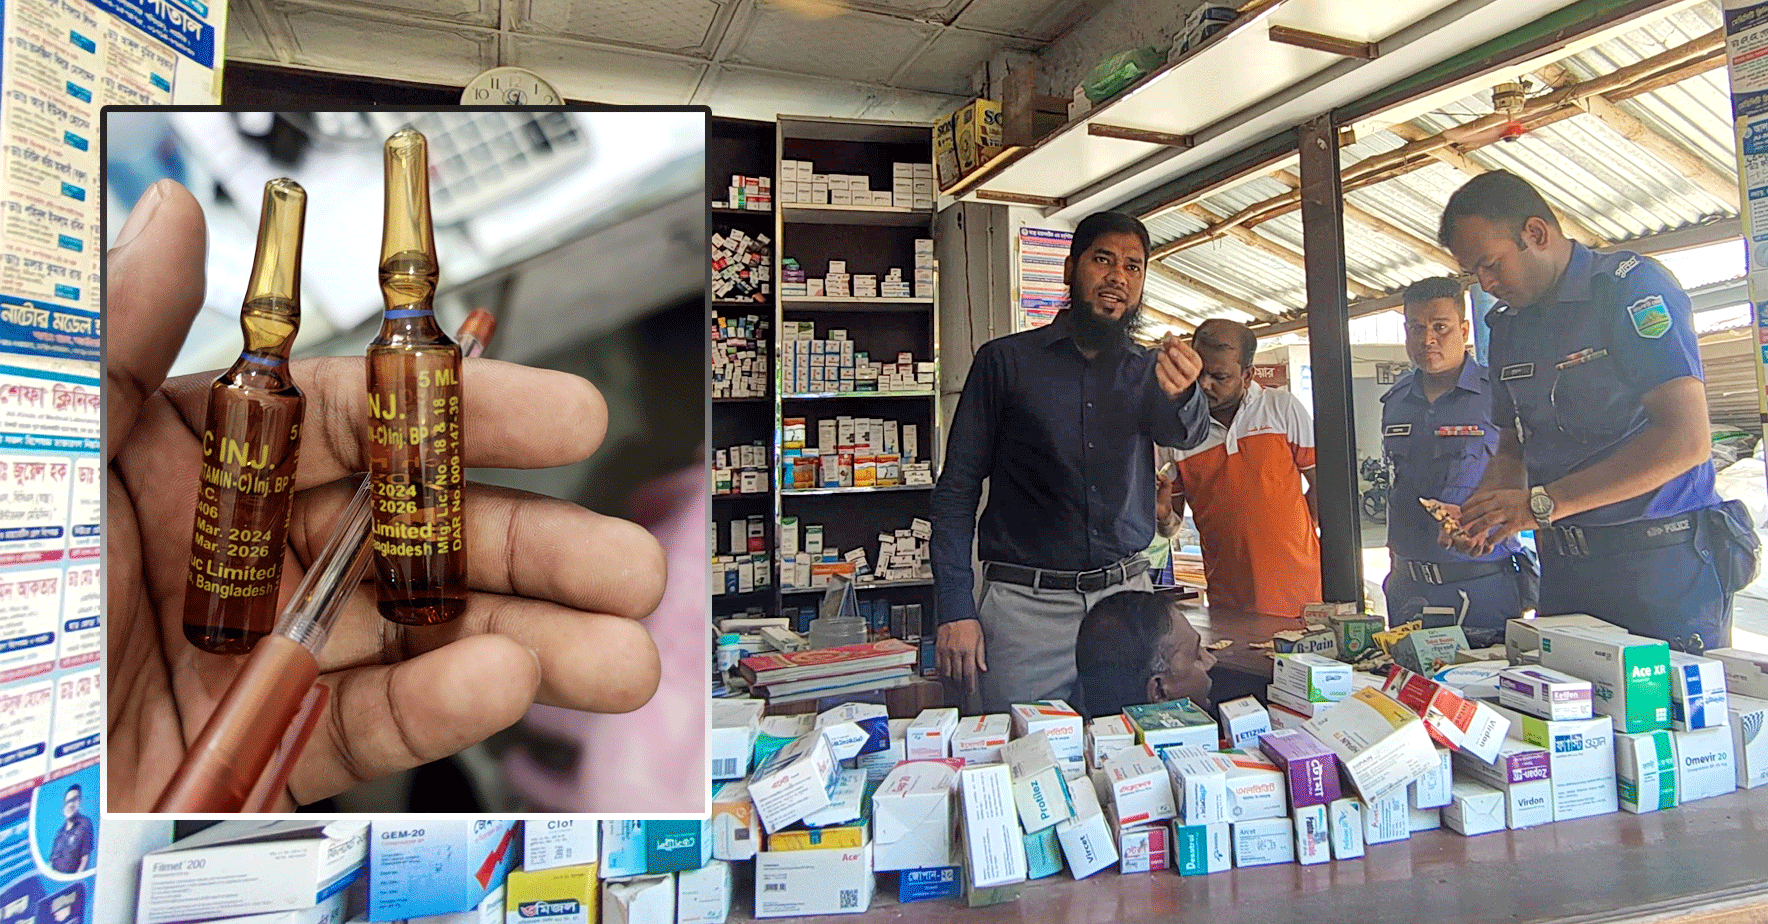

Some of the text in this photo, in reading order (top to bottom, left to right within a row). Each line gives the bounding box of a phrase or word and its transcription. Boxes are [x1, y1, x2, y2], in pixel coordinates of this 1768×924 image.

[475, 88, 489, 100] 10
[52, 311, 92, 335] মডেল
[418, 367, 459, 390] 5 ML
[432, 397, 446, 418] 18
[409, 426, 429, 446] BP
[203, 430, 214, 457] C
[219, 436, 276, 471] INJ.
[434, 438, 447, 457] 18
[435, 459, 448, 487] No.
[274, 475, 289, 494] BP
[378, 484, 418, 498] 2024
[379, 499, 419, 514] 2026
[436, 489, 449, 518] Lic.
[197, 516, 272, 543] Mar. 2024
[452, 515, 463, 552] DAR
[195, 532, 269, 558] Mar. 2026
[206, 559, 277, 582] Limited
[196, 575, 273, 600] Bangladesh
[1632, 663, 1667, 679] Ace XR
[1685, 751, 1728, 767] Omevir 20
[1030, 779, 1050, 821] Protilez
[1517, 796, 1545, 808] Virdon
[381, 828, 426, 840] GEM-20
[842, 853, 859, 862] Ace
[1079, 836, 1094, 864] Vircet
[187, 858, 207, 870] 200
